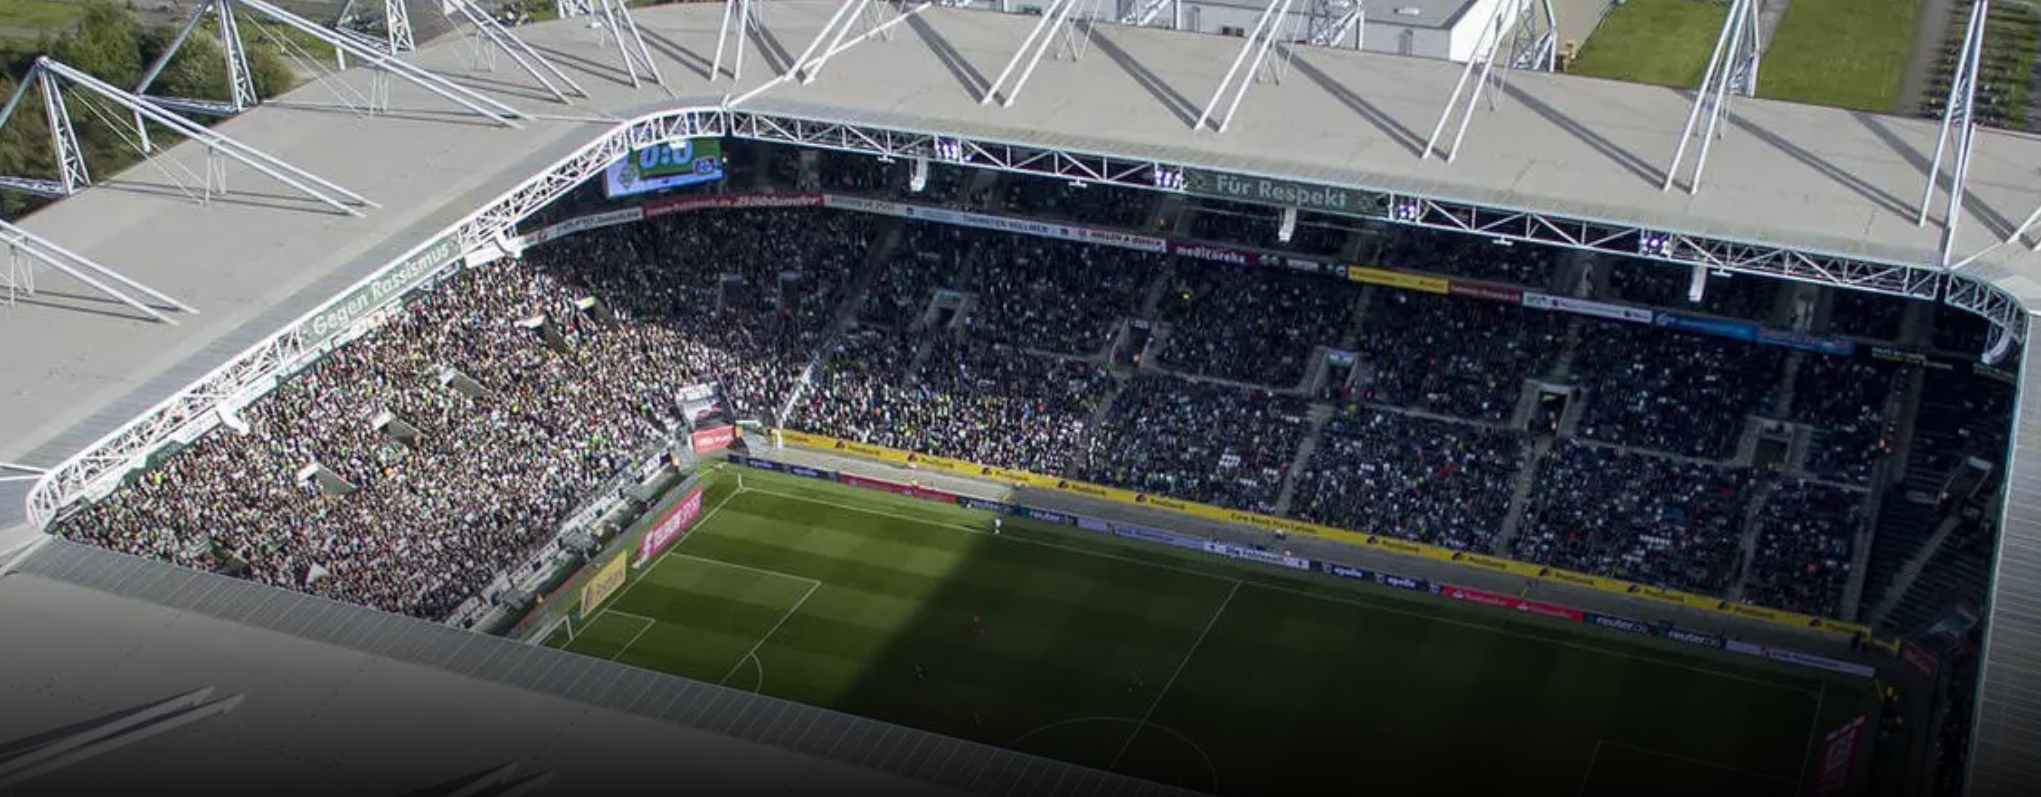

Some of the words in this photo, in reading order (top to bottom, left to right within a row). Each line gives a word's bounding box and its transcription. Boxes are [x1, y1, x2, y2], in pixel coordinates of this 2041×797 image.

[1216, 174, 1253, 195] Für
[1259, 182, 1347, 208] Respekt
[313, 295, 369, 335] Gegen
[371, 242, 450, 300] Rassismus
